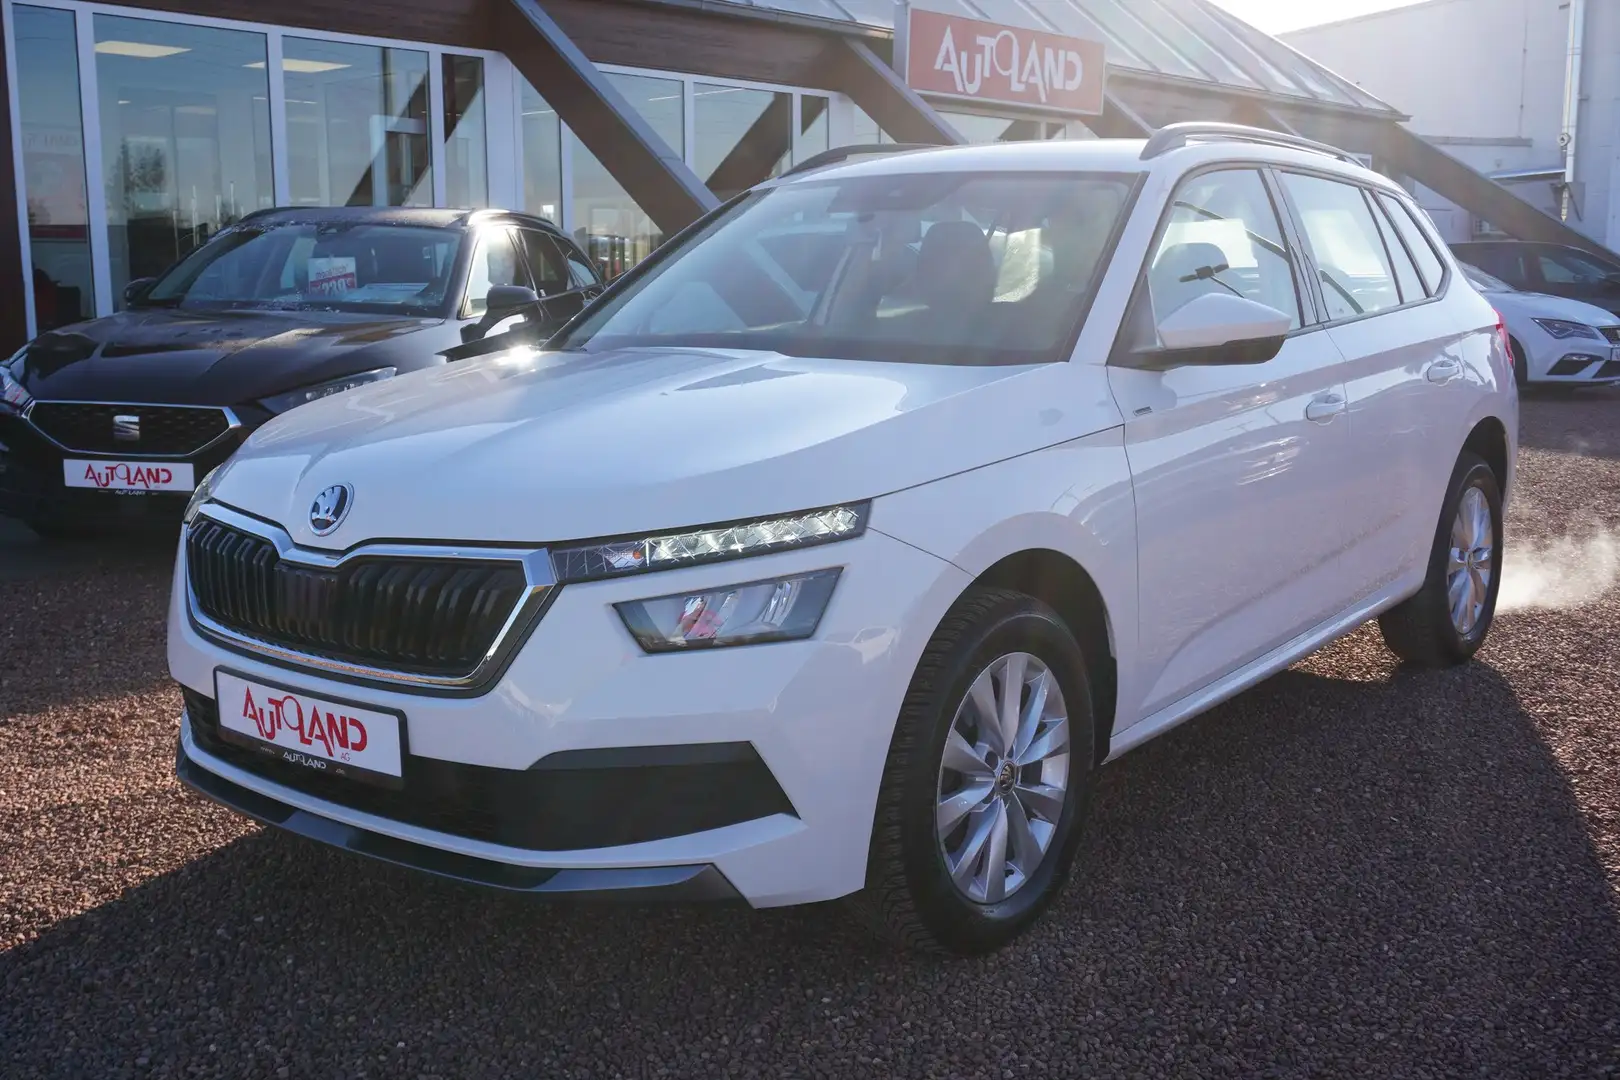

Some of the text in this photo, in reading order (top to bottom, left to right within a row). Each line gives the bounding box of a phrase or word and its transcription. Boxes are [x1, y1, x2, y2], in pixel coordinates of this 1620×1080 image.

[934, 24, 1083, 103] AUTOLAND
[84, 463, 173, 488] AUTOLAND
[243, 686, 368, 757] AUTOLAND
[283, 751, 327, 770] AUTOLAND
